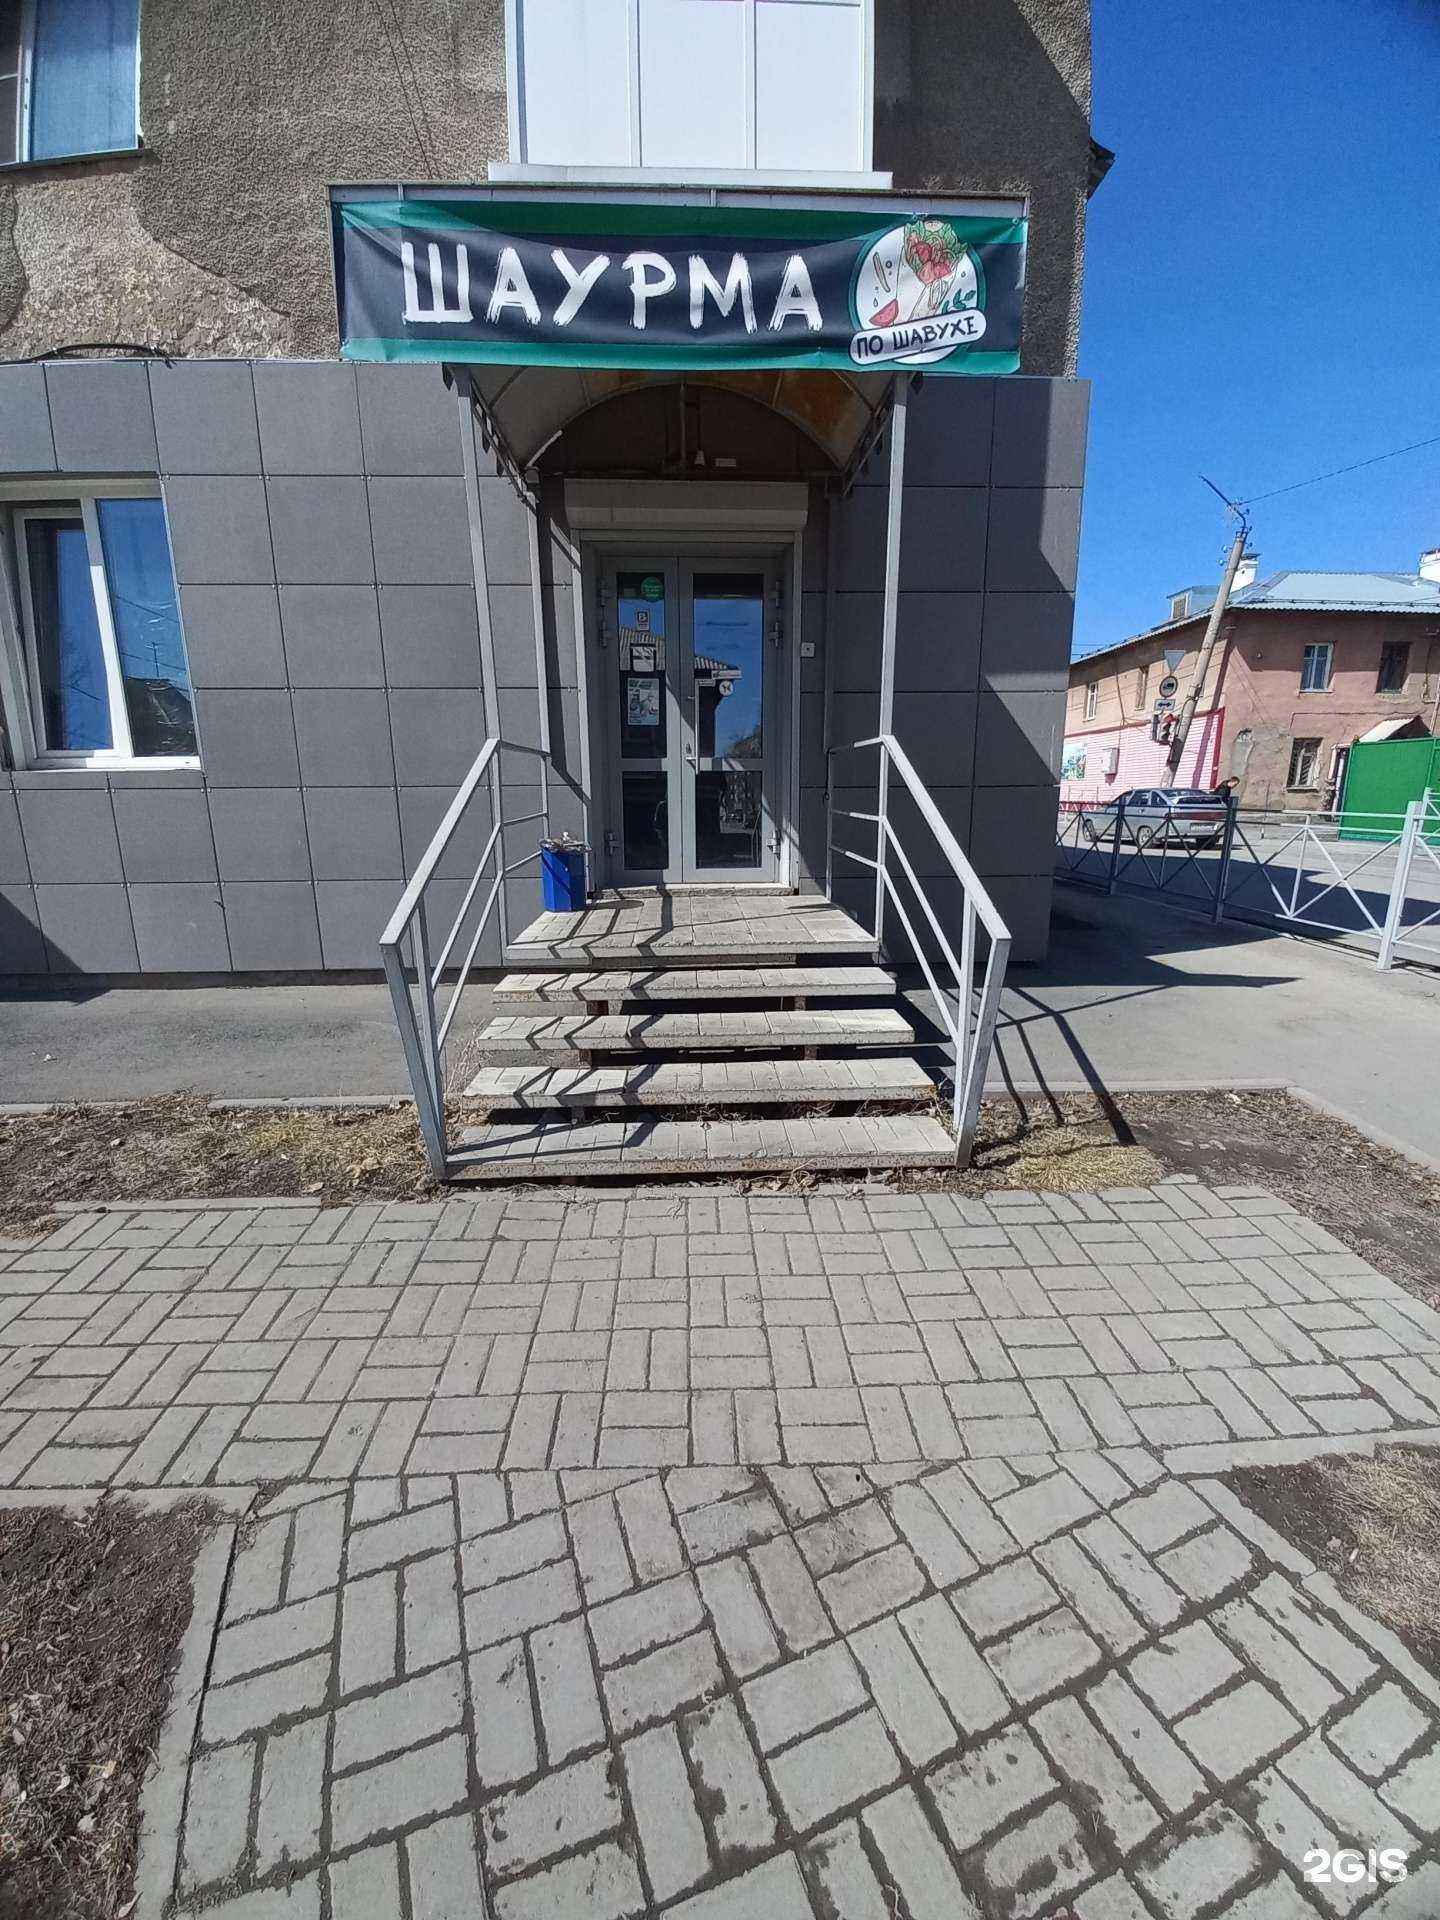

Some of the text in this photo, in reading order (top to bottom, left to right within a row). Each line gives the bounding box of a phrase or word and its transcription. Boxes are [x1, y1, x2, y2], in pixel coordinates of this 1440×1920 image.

[401, 241, 823, 335] ШАУРМА
[856, 315, 979, 359] ПО ШАВУХЕ
